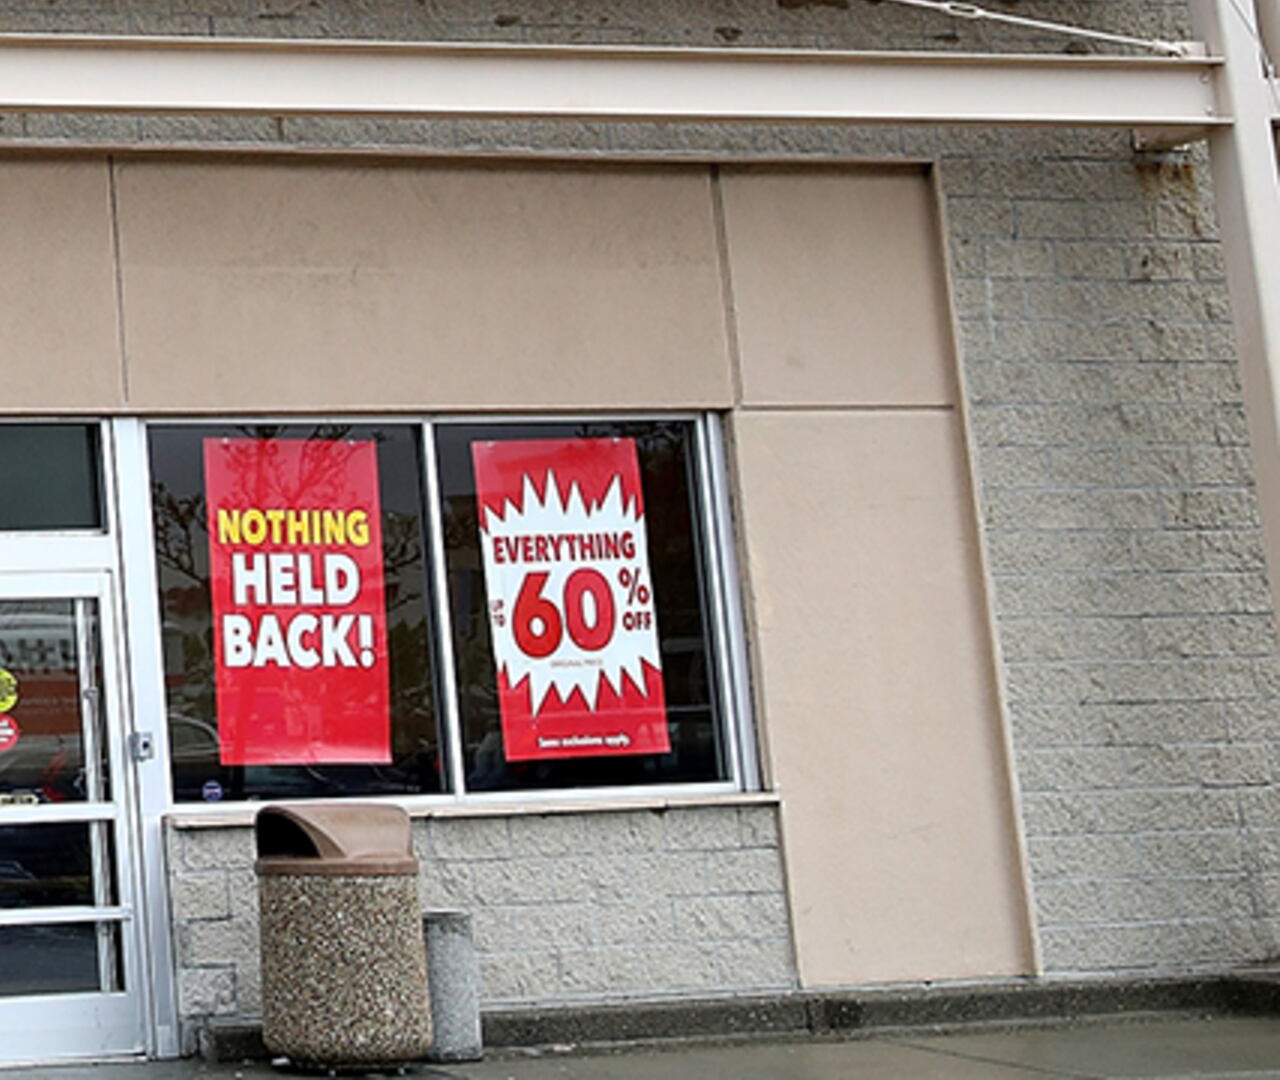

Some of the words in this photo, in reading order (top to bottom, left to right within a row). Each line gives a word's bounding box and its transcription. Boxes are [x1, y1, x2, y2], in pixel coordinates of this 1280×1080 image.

[216, 509, 370, 546] NOTHING
[492, 531, 636, 564] EVERYTHING
[231, 552, 360, 605] HELD
[622, 611, 652, 631] OFF
[222, 613, 375, 668] BACK!
